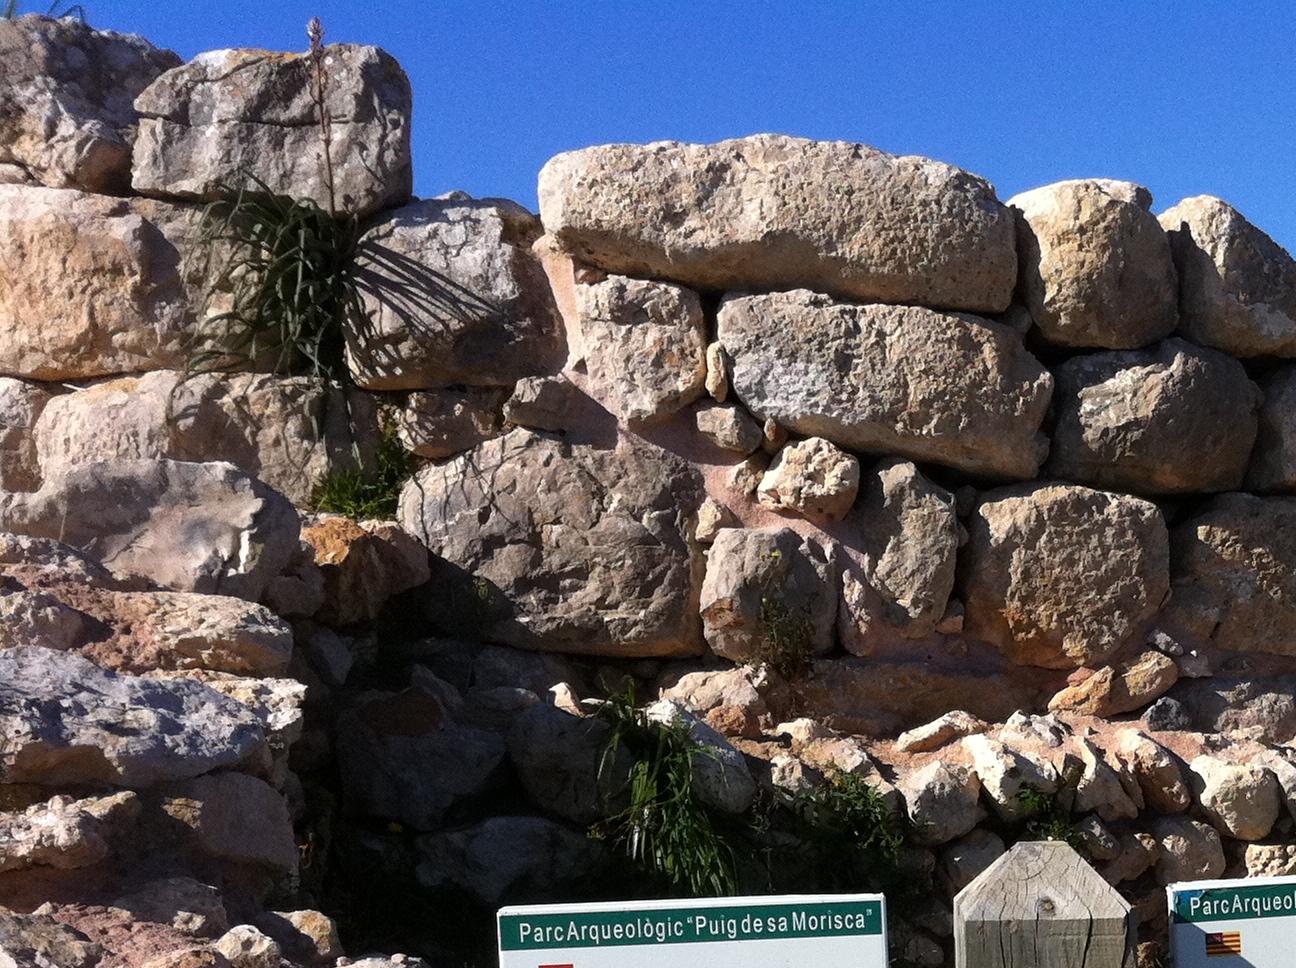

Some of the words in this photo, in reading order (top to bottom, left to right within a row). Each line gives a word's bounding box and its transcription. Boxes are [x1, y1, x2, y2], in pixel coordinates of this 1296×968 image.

[1190, 896, 1229, 916] Parc
[519, 920, 564, 944] Parc
[567, 919, 684, 944] Arqueològic
[741, 916, 763, 934] de
[767, 917, 789, 933] sa
